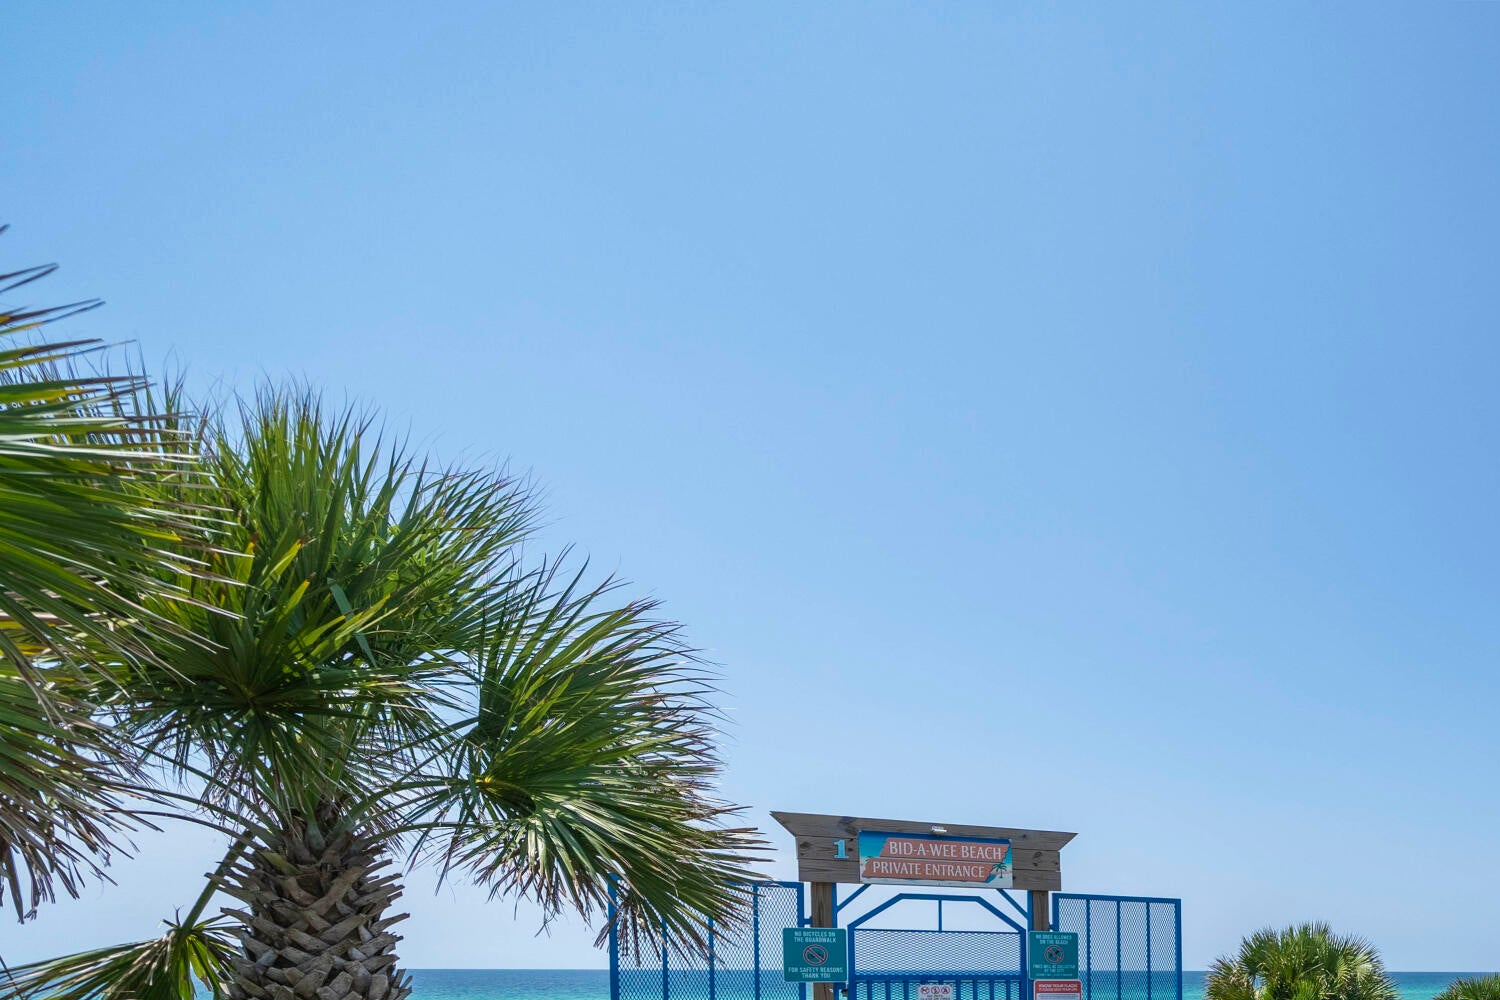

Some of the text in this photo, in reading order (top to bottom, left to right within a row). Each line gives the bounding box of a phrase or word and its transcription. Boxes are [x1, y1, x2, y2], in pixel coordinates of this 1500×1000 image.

[832, 839, 849, 859] 1
[888, 841, 1001, 860] BID-A-WEE BEACH
[872, 861, 984, 878] PRIVATE ENTRANCE
